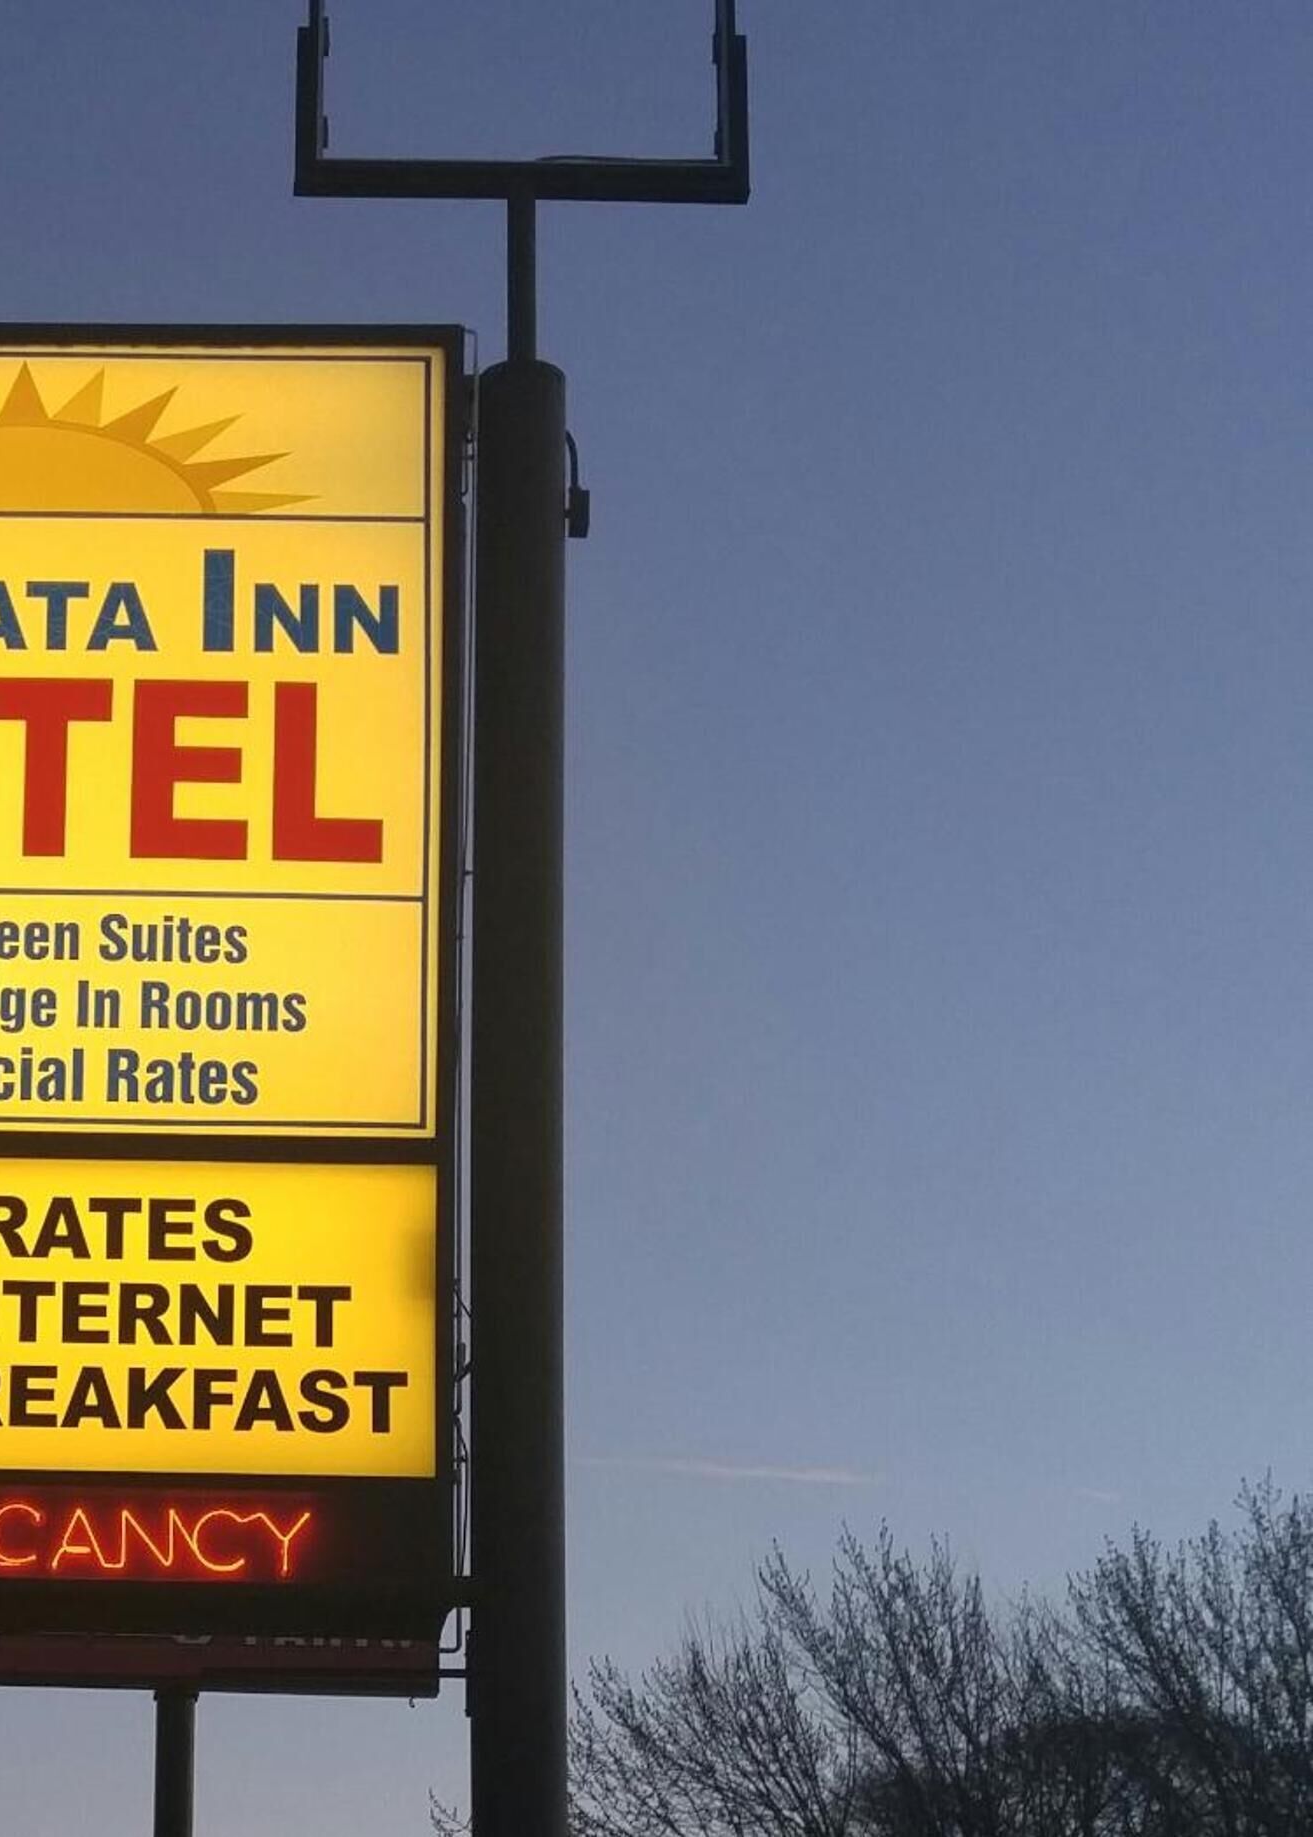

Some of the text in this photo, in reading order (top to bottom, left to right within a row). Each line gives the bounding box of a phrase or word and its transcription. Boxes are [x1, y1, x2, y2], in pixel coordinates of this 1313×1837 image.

[100, 914, 247, 963] Suites
[78, 981, 119, 1028] In
[141, 981, 306, 1031] Rooms
[107, 1049, 257, 1105] Rates
